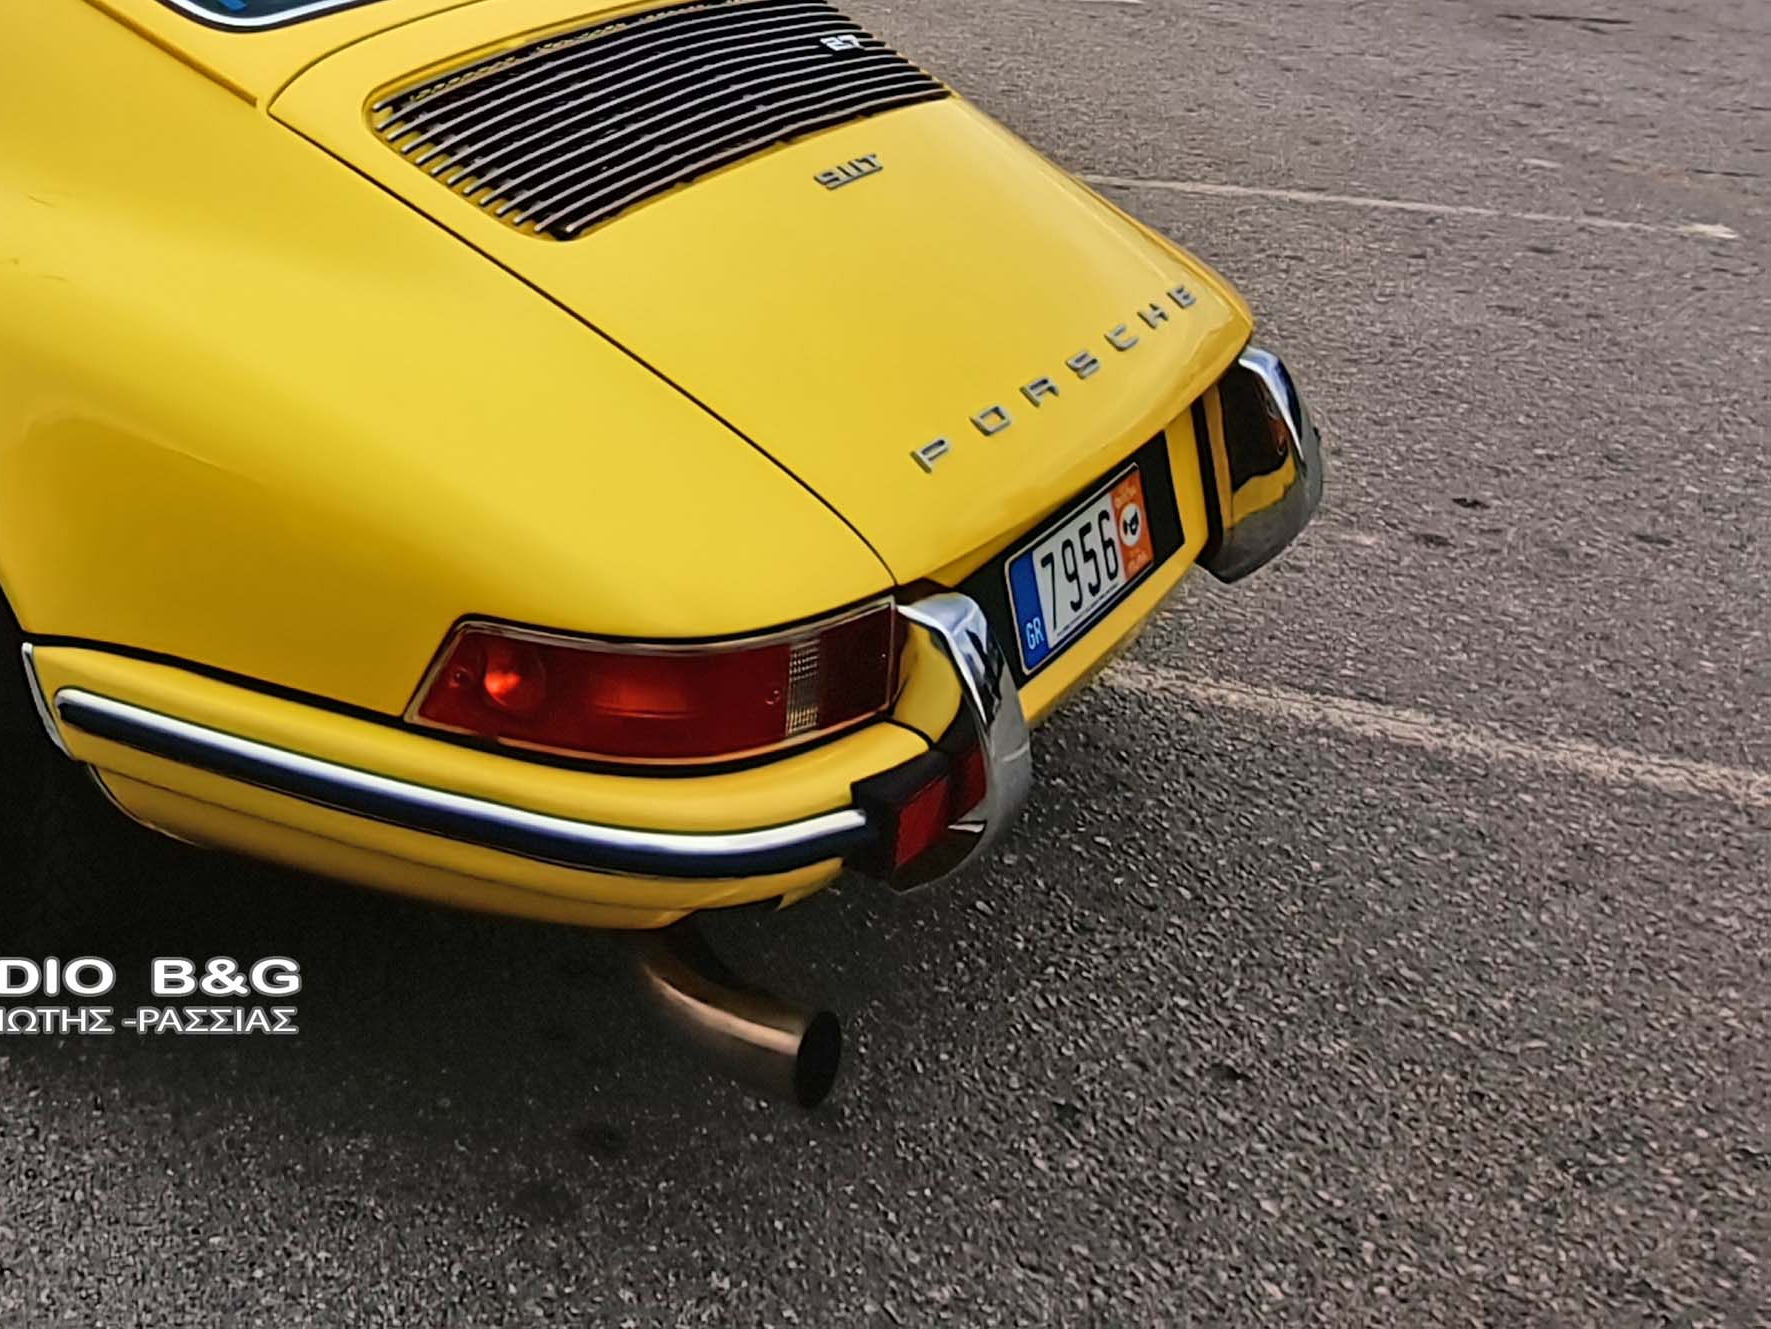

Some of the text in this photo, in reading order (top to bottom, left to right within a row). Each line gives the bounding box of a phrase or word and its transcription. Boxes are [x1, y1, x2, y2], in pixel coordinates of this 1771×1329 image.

[910, 284, 1197, 474] PORSCHE
[1025, 616, 1044, 650] GR
[1040, 509, 1119, 633] 7956
